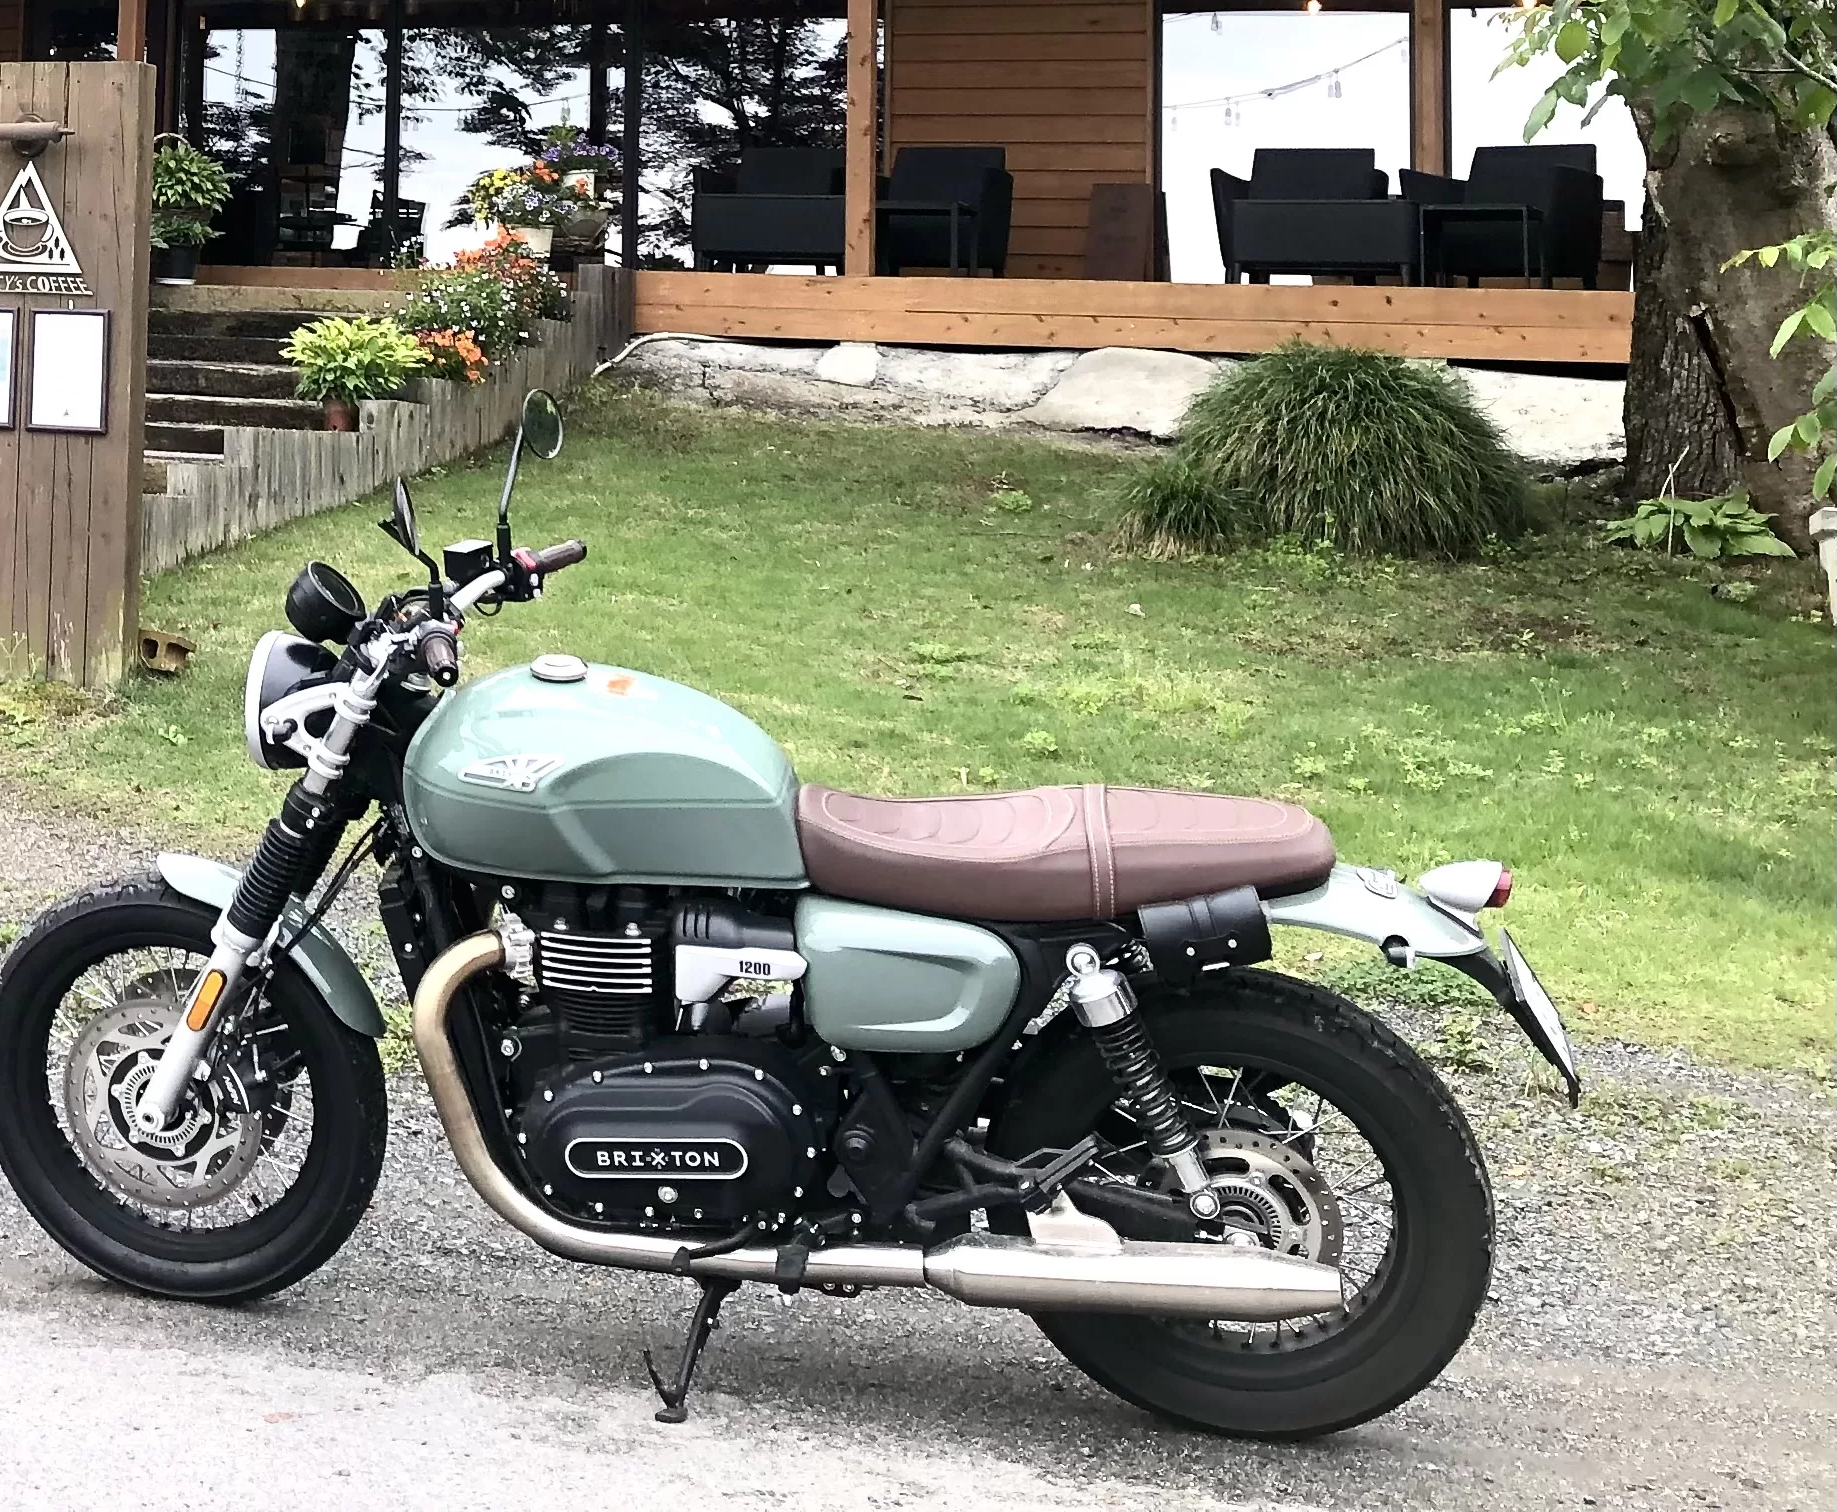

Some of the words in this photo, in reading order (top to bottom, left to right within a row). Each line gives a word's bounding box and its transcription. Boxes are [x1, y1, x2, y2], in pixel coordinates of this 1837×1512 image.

[26, 275, 90, 294] COFFEE
[739, 960, 771, 976] 1200
[596, 1149, 720, 1168] BRIXTON
